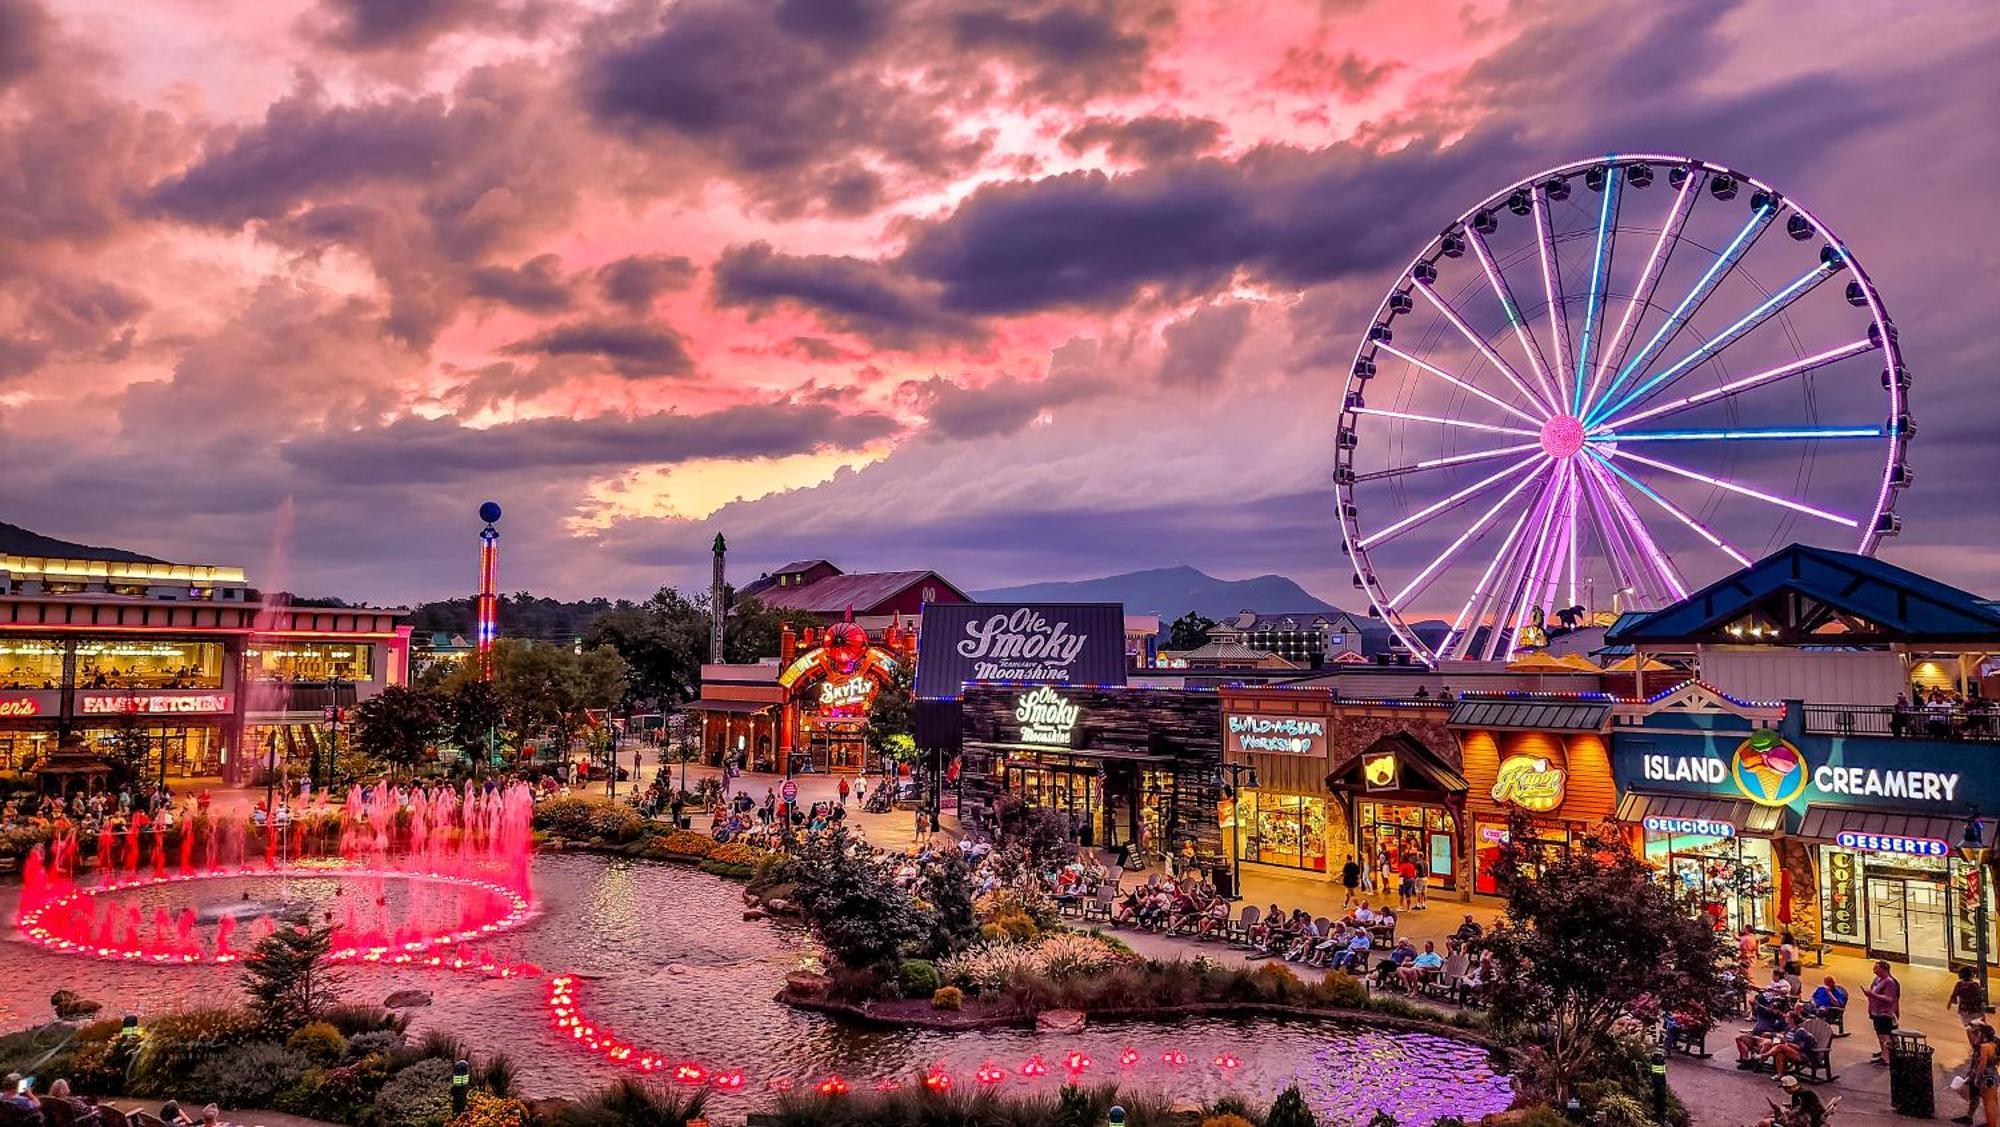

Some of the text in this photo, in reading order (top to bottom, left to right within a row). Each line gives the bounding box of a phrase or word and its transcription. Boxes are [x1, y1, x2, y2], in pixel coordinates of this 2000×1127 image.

[1008, 607, 1052, 633] Ole
[956, 614, 1087, 666] Smoky
[974, 661, 1069, 680] Moonshine
[149, 696, 226, 713] KITCHEN
[1040, 687, 1060, 704] Ole
[1016, 691, 1080, 730] Smoky
[1240, 734, 1312, 753] WORKSHOP
[1643, 754, 1957, 800] ISLAND CREAMERY
[1649, 818, 1730, 836] DELICIOUS
[1843, 834, 1941, 854] DESSERTS
